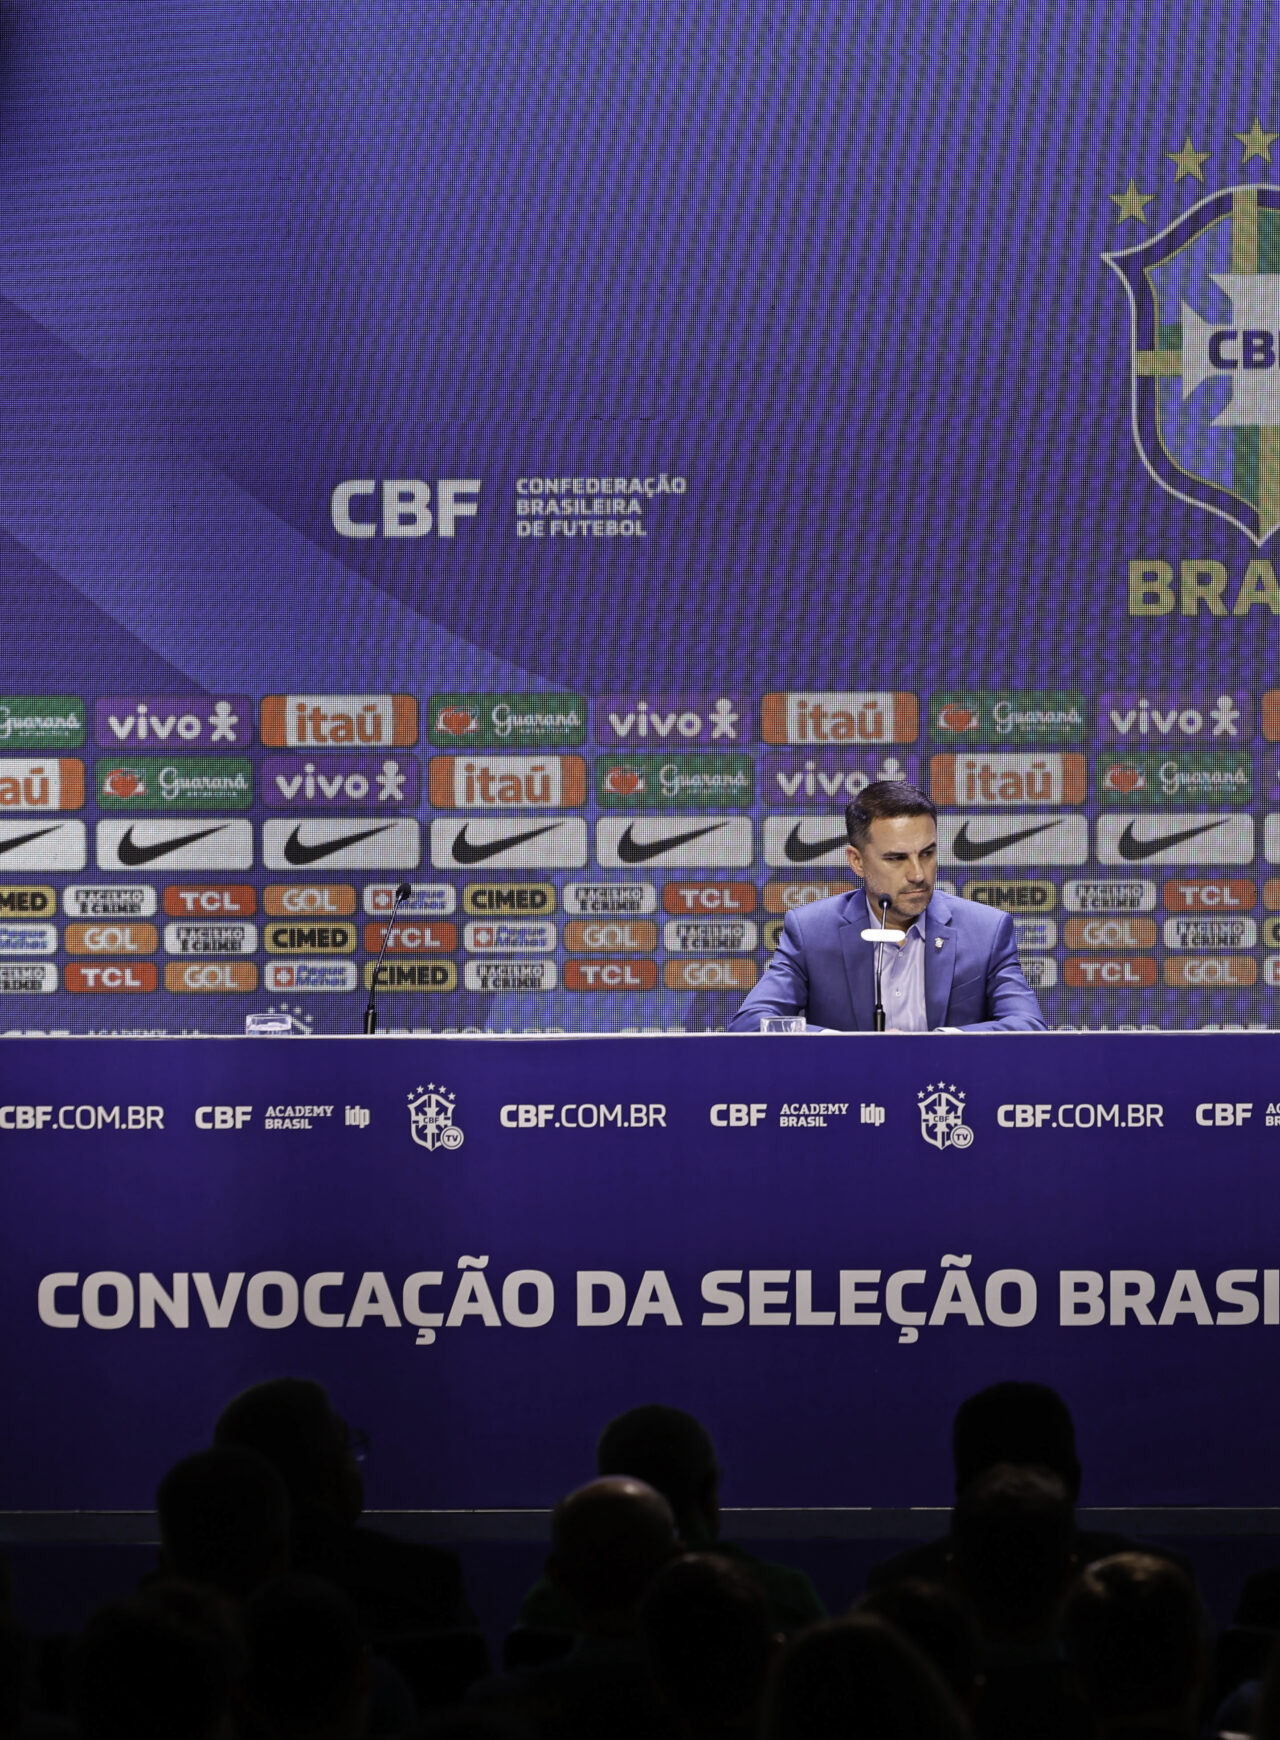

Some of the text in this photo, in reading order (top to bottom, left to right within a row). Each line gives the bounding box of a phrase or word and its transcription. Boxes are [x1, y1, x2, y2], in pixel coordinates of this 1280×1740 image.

[516, 473, 687, 499] CONFEDERAÇÃO
[331, 479, 481, 538] CBF
[516, 498, 642, 515] BRASILEIRA
[517, 519, 647, 537] DE FUTEBOL
[109, 705, 201, 739] vivo
[297, 703, 382, 742] itaú
[491, 704, 581, 736] Guaraná
[609, 703, 701, 736] vivo
[798, 701, 883, 740] itaú
[992, 701, 1082, 733] Guaraná
[1110, 700, 1203, 734] vivo
[0, 766, 49, 806] aú
[158, 767, 248, 800] Guaraná
[276, 765, 368, 798] vivo
[466, 765, 550, 803] itaú
[659, 764, 749, 796] Guaraná
[777, 762, 869, 795] vivo
[966, 761, 1052, 800] itaú
[1159, 761, 1248, 794] Guaraná
[0, 891, 48, 911] MED
[179, 891, 239, 911] TCL
[282, 888, 336, 912] GOL
[471, 889, 547, 909] CIMED
[679, 888, 739, 908] TCL
[971, 887, 1047, 906] CIMED
[1179, 885, 1239, 905] TCL
[84, 927, 137, 950] GOL
[272, 928, 348, 948] CIMED
[381, 928, 440, 948] TCL
[583, 924, 637, 948] GOL
[1083, 921, 1137, 946] GOL
[81, 967, 141, 987] TCL
[184, 965, 237, 988] GOL
[373, 966, 448, 986] CIMED
[580, 965, 640, 985] TCL
[683, 962, 738, 986] GOL
[1080, 962, 1139, 981] TCL
[1183, 959, 1237, 983] GOL
[0, 1105, 164, 1129] CBF.COM.BR
[195, 1106, 252, 1129] CBF
[265, 1106, 334, 1117] ACADEMY
[345, 1106, 370, 1128] idp
[500, 1104, 667, 1128] CBF.COM.BR
[710, 1104, 767, 1127] CBF
[780, 1104, 849, 1115] ACADEMY
[861, 1104, 885, 1127] idp
[997, 1104, 1164, 1128] CBF.COM.BR
[1196, 1103, 1252, 1126] CBF
[265, 1119, 312, 1129] BRASIL
[780, 1117, 827, 1127] BRASIL
[445, 1134, 459, 1142] TV
[955, 1133, 968, 1141] TV
[38, 1255, 554, 1345] CONVOCAÇÃO
[577, 1270, 683, 1326] DA
[701, 1254, 1037, 1344] SELEÇÃO
